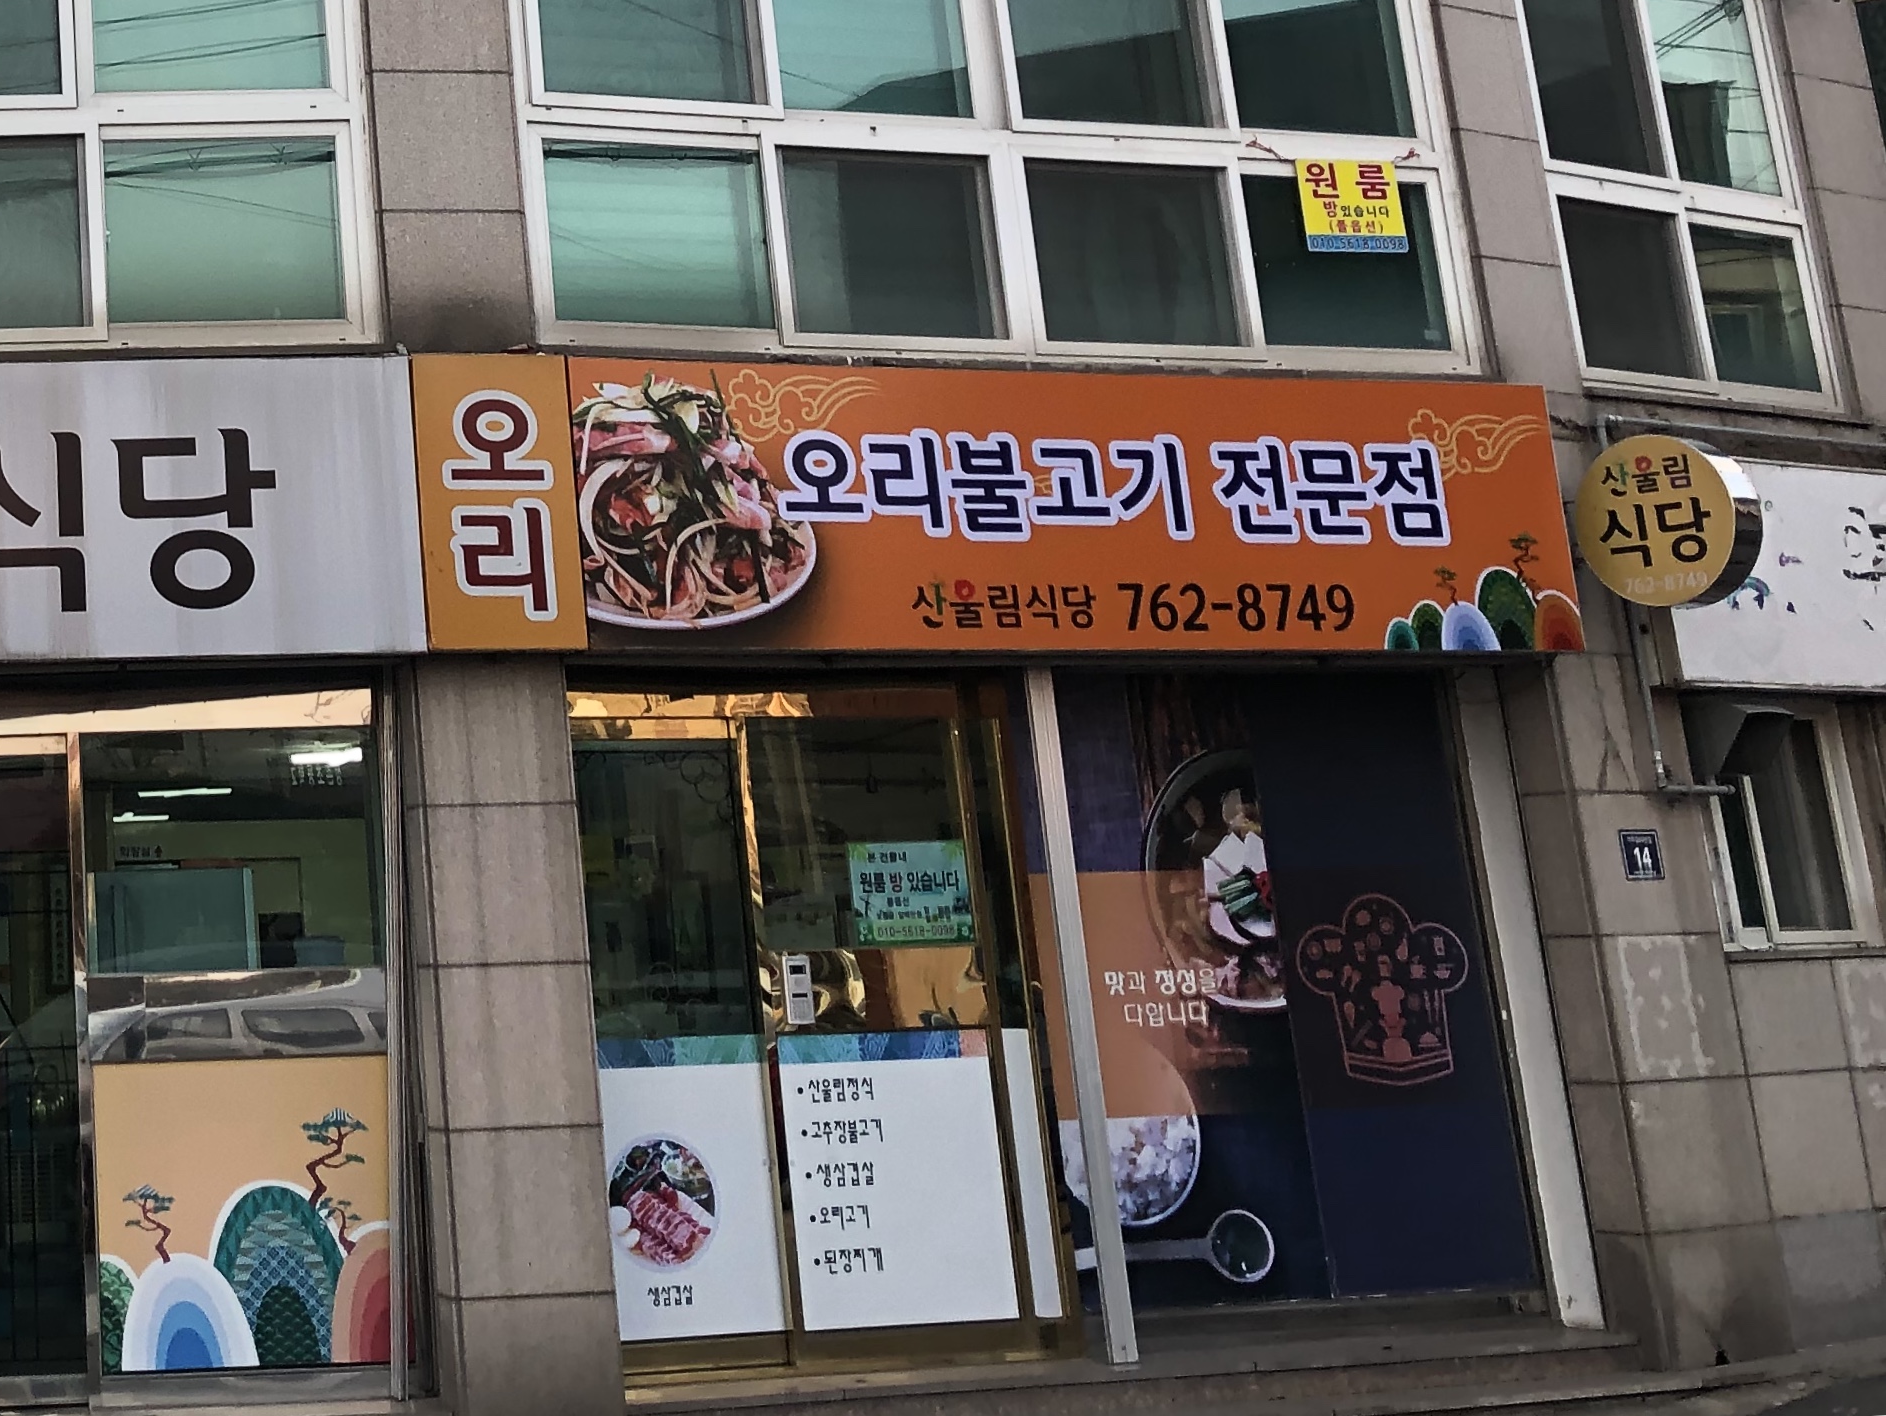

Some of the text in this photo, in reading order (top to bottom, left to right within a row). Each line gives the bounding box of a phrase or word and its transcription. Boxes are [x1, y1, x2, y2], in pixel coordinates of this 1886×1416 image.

[1304, 162, 1391, 201] 원룸
[1322, 200, 1390, 219] 방 있습니다
[1311, 236, 1335, 250] 010
[1374, 237, 1405, 250] 0098
[784, 431, 1450, 545] 오리불고기 전문점
[1601, 453, 1694, 497] 산울림
[445, 391, 554, 620] 오리
[1599, 496, 1712, 569] 식당
[911, 576, 1355, 633] 산울림식당 762-8749
[1633, 846, 1653, 874] 14
[859, 870, 960, 894] 원룸 방 있습니다
[1104, 968, 1217, 996] 맛과 정성을
[808, 1076, 875, 1103] 산울림정식
[811, 1118, 884, 1145] 고추장불고기
[816, 1161, 875, 1188] 생삼겹살
[819, 1204, 871, 1231] 오리고기
[824, 1246, 885, 1275] 된장찌개
[647, 1284, 693, 1308] 생삼겹살
